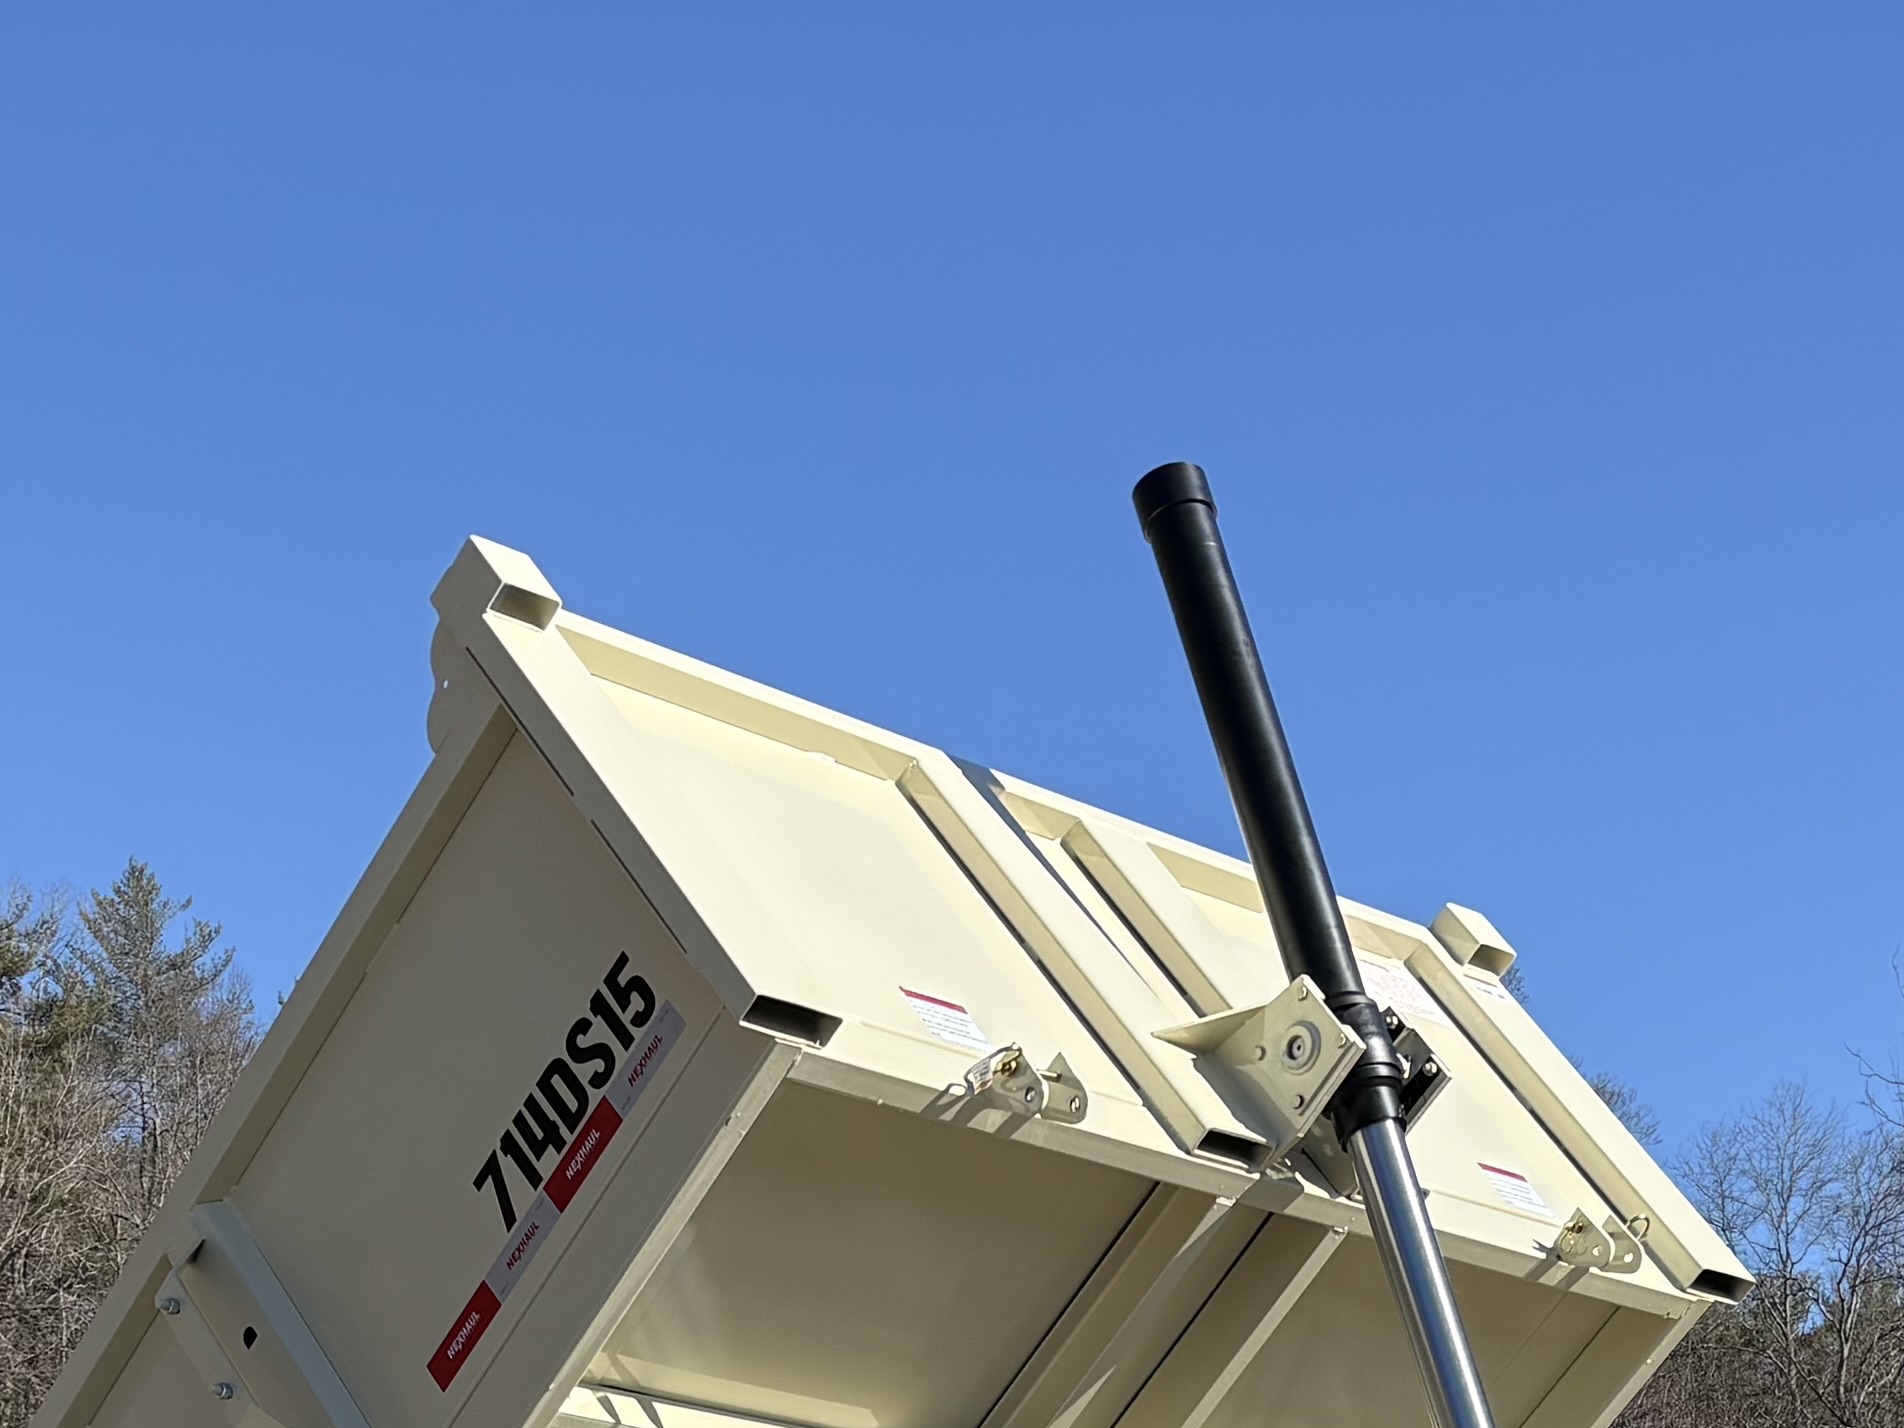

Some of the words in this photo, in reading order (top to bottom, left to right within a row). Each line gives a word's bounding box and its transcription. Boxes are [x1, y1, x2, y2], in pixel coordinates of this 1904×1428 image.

[627, 1034, 663, 1087] NEXHAUL
[473, 950, 656, 1233] 714DS15
[565, 1129, 601, 1180] NEXHAUL
[506, 1221, 540, 1271] NEXHAUL
[446, 1311, 480, 1360] NEXHAUL
